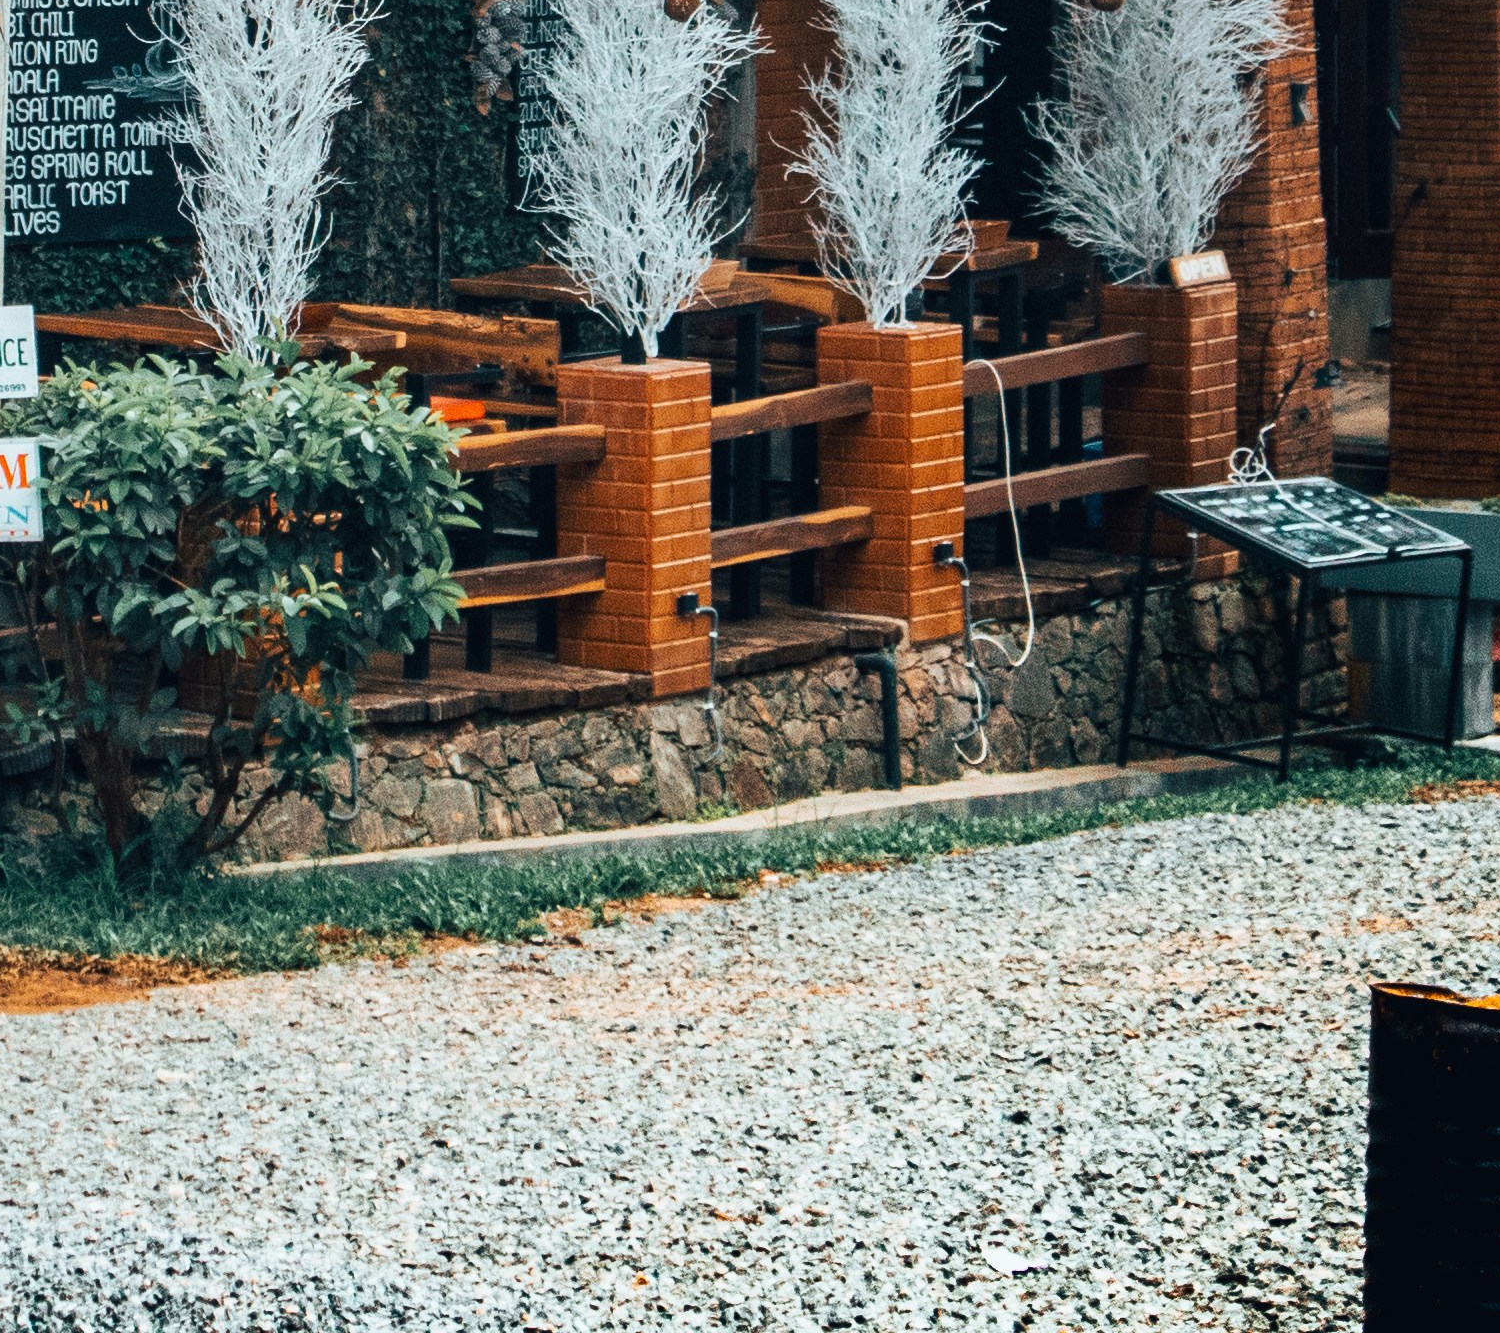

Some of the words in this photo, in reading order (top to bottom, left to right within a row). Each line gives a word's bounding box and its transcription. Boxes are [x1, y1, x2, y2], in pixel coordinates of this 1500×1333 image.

[30, 11, 75, 37] CHILI
[55, 38, 99, 64] RING
[31, 152, 100, 180] SPRING
[105, 150, 153, 177] ROLL
[65, 180, 130, 207] TOAST
